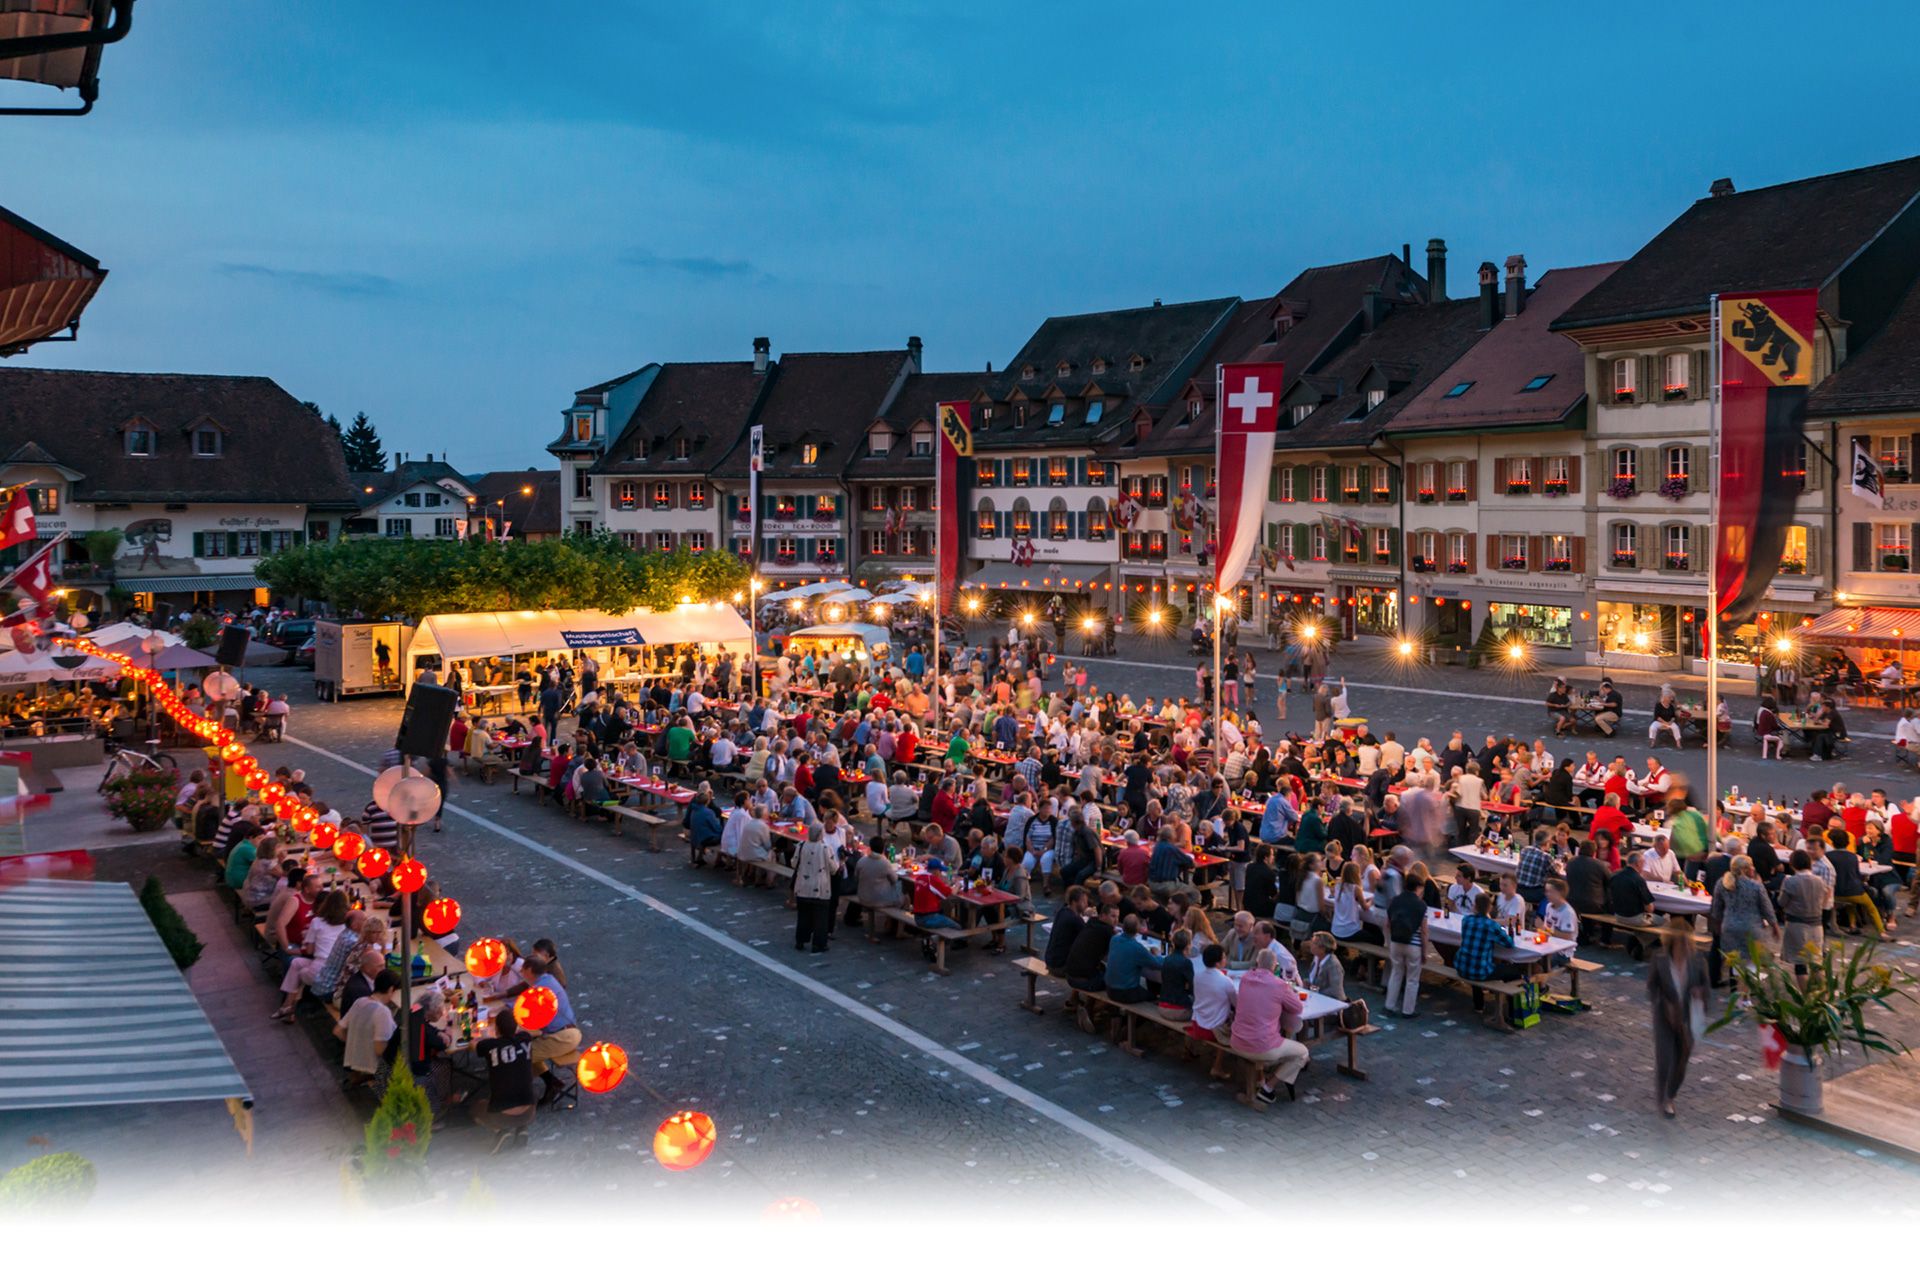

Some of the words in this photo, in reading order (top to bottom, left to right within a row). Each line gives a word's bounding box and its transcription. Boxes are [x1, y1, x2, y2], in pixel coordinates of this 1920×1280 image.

[1881, 497, 1919, 511] Res
[36, 521, 67, 529] aucon
[740, 523, 785, 531] COTOREI
[565, 630, 637, 640] Musikgesellschaft
[0, 673, 27, 683] oca-Cola
